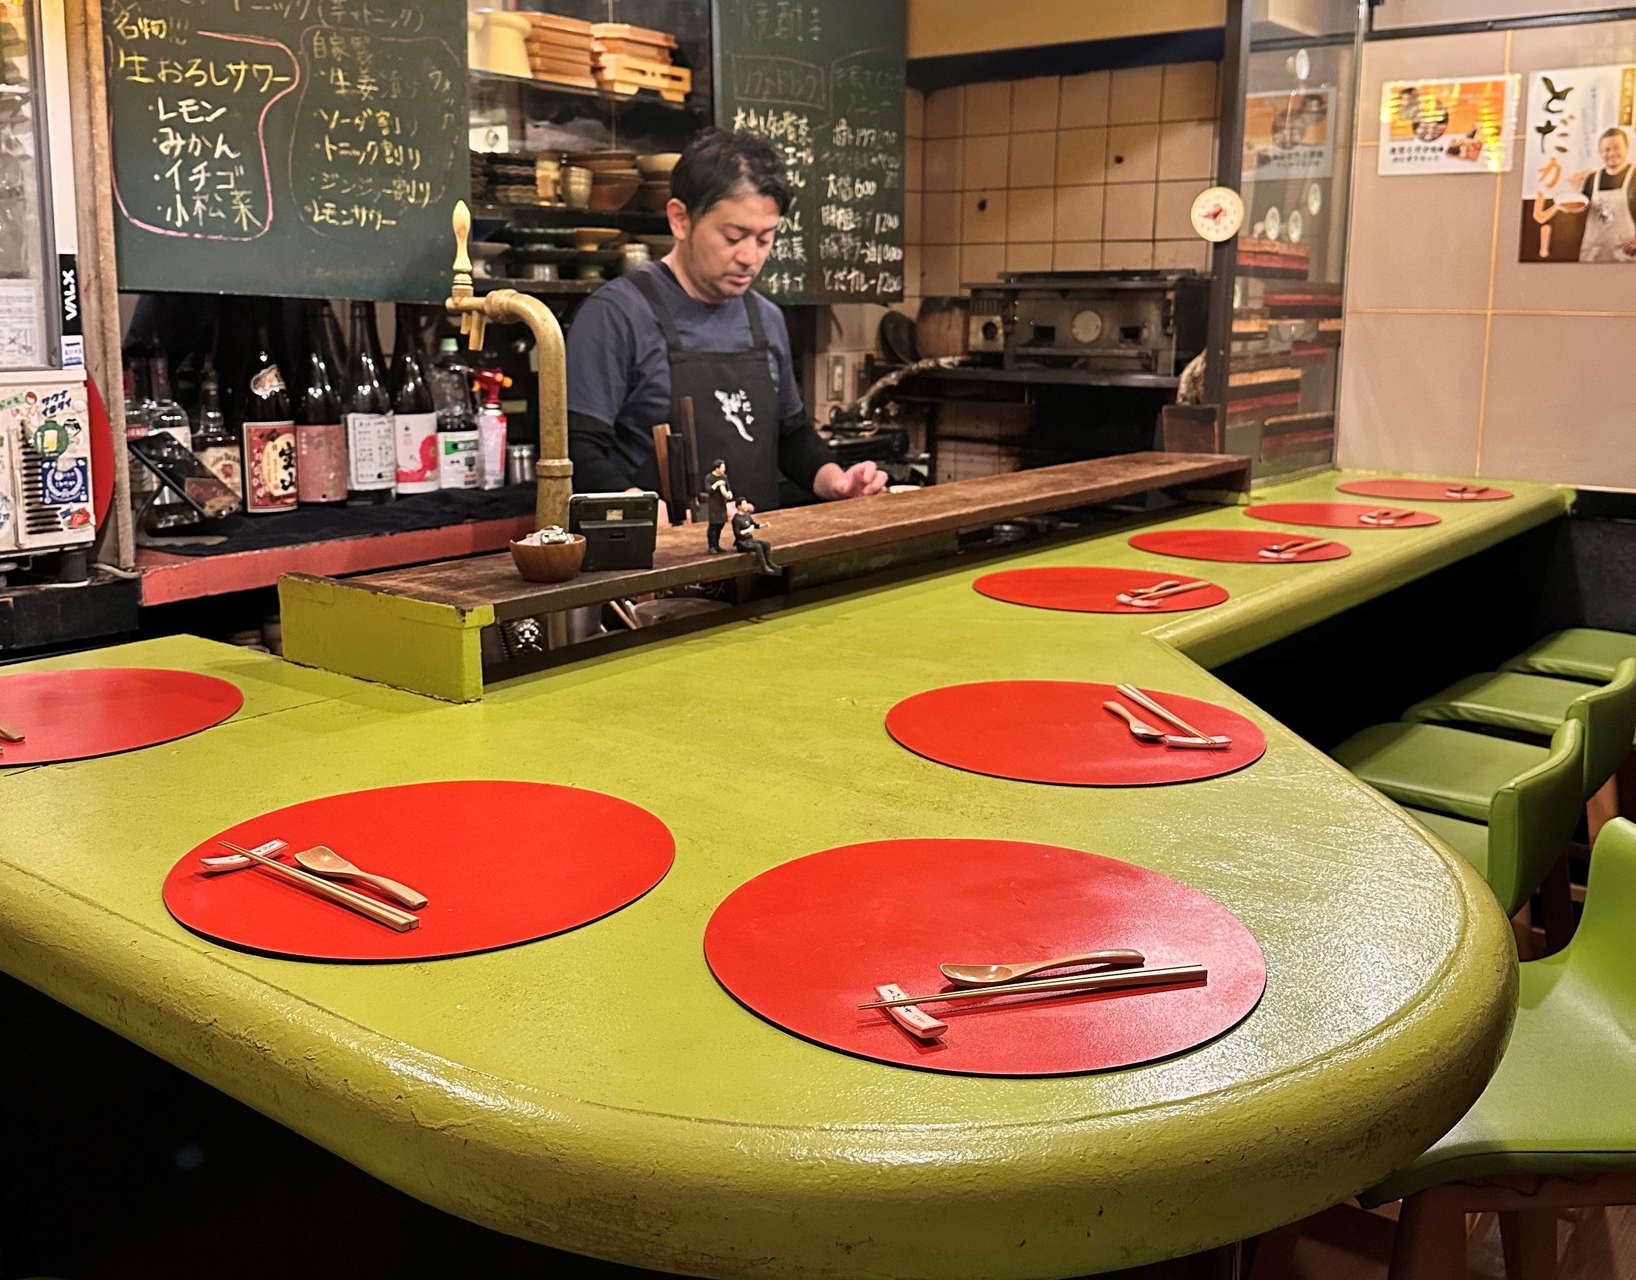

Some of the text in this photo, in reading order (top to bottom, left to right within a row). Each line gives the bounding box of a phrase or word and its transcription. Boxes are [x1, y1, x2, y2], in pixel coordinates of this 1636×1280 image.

[118, 48, 291, 94] 生おろしサワー
[61, 269, 79, 322] VALX
